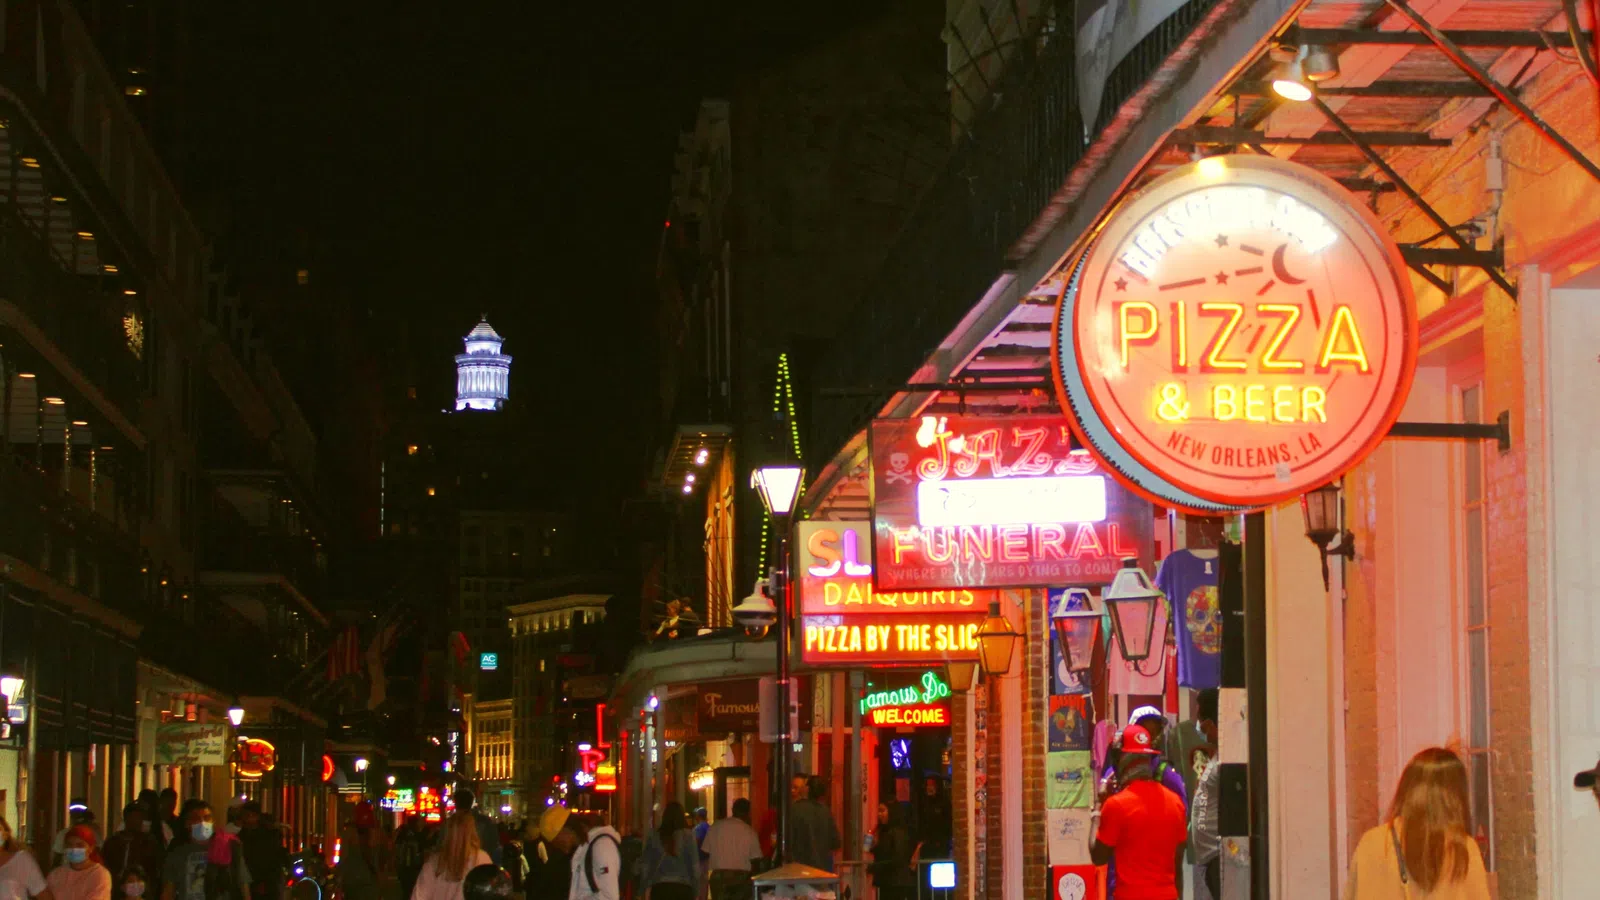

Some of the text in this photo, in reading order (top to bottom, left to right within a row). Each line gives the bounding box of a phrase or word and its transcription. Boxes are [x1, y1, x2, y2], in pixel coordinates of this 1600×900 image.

[1113, 301, 1371, 374] PIZZA
[1157, 382, 1327, 423] & BEER
[1167, 431, 1322, 468] NEW ORLEANS, LA
[808, 528, 872, 577] SL
[891, 523, 1138, 565] FUNERAL
[889, 566, 936, 580] WHERE
[990, 563, 1015, 578] ARE
[1018, 561, 1060, 578] DYING
[1064, 563, 1081, 577] TO
[805, 623, 979, 652] PIZZA BY THE SLIC
[482, 655, 496, 663] AC
[922, 671, 950, 704] Do
[873, 708, 945, 724] WELCOME
